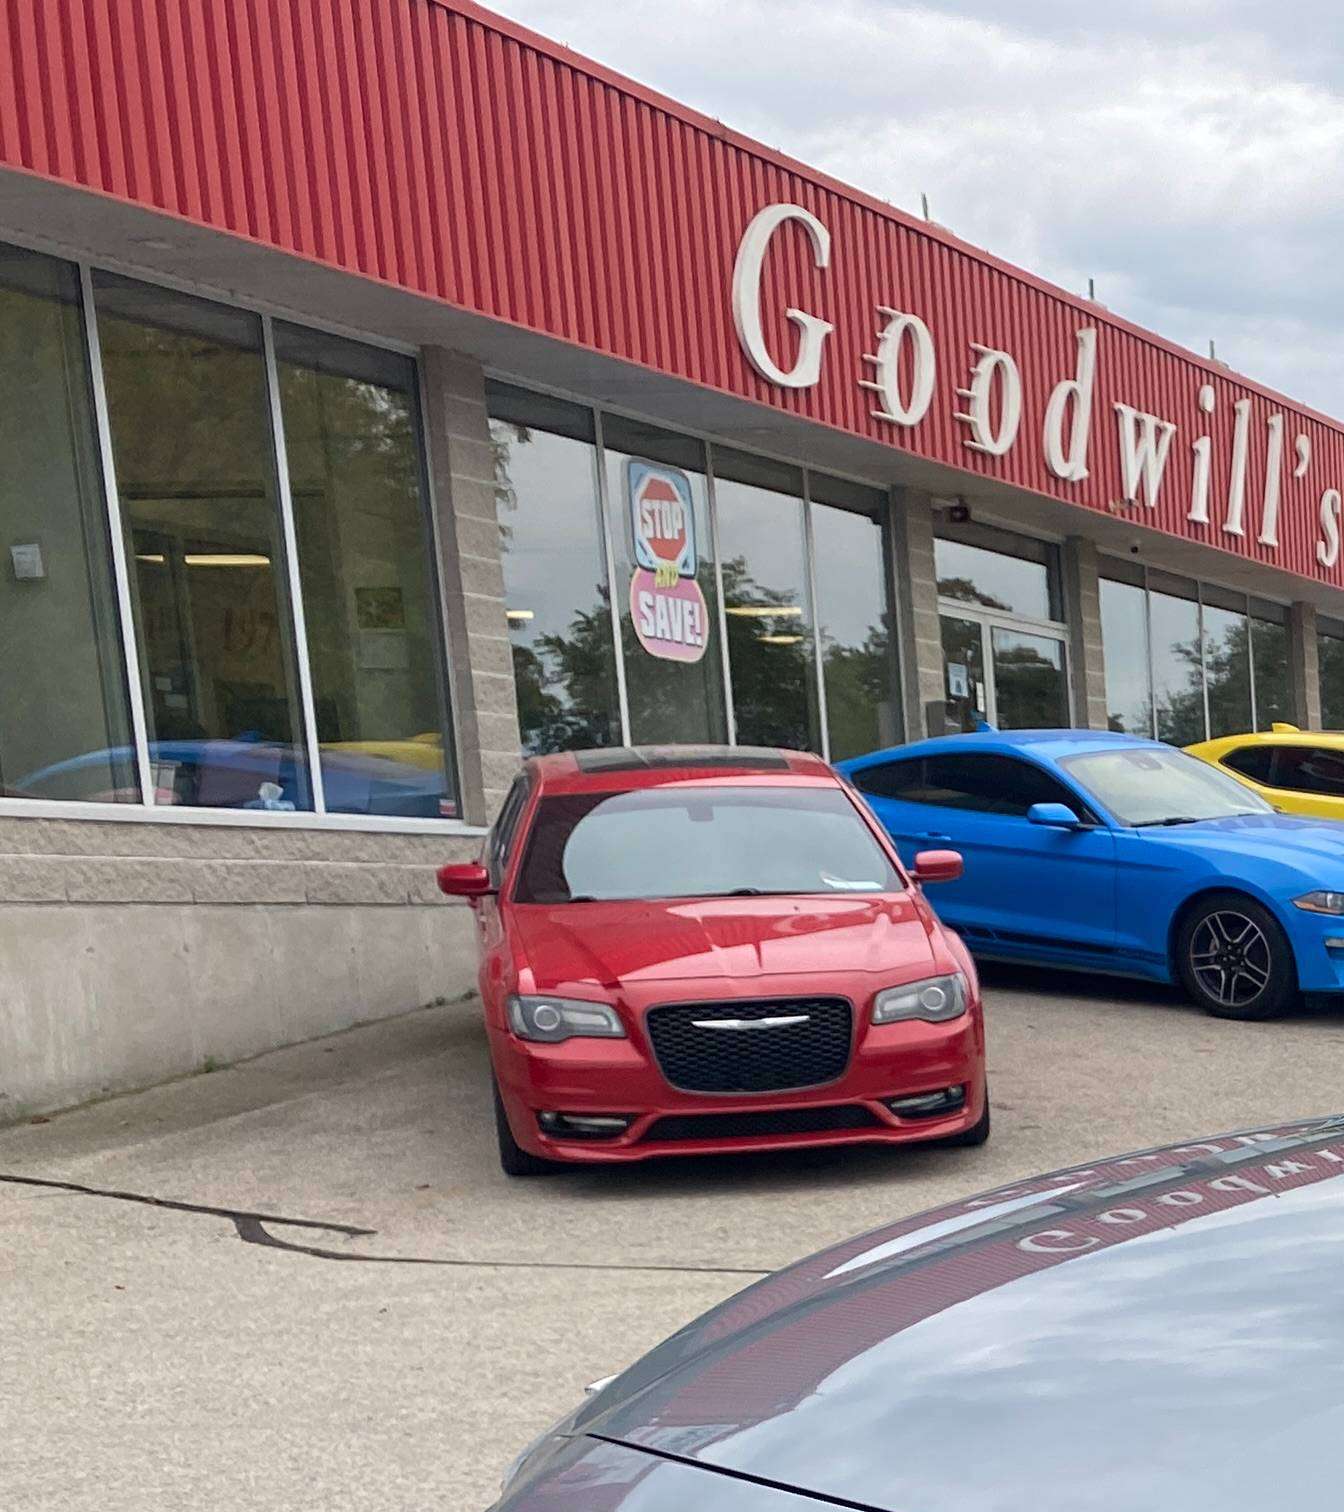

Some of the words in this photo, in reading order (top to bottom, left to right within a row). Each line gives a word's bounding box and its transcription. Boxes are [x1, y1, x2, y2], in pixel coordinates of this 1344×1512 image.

[732, 203, 1342, 567] Goodwill's
[640, 500, 685, 540] STOP
[638, 591, 703, 648] SAVE!
